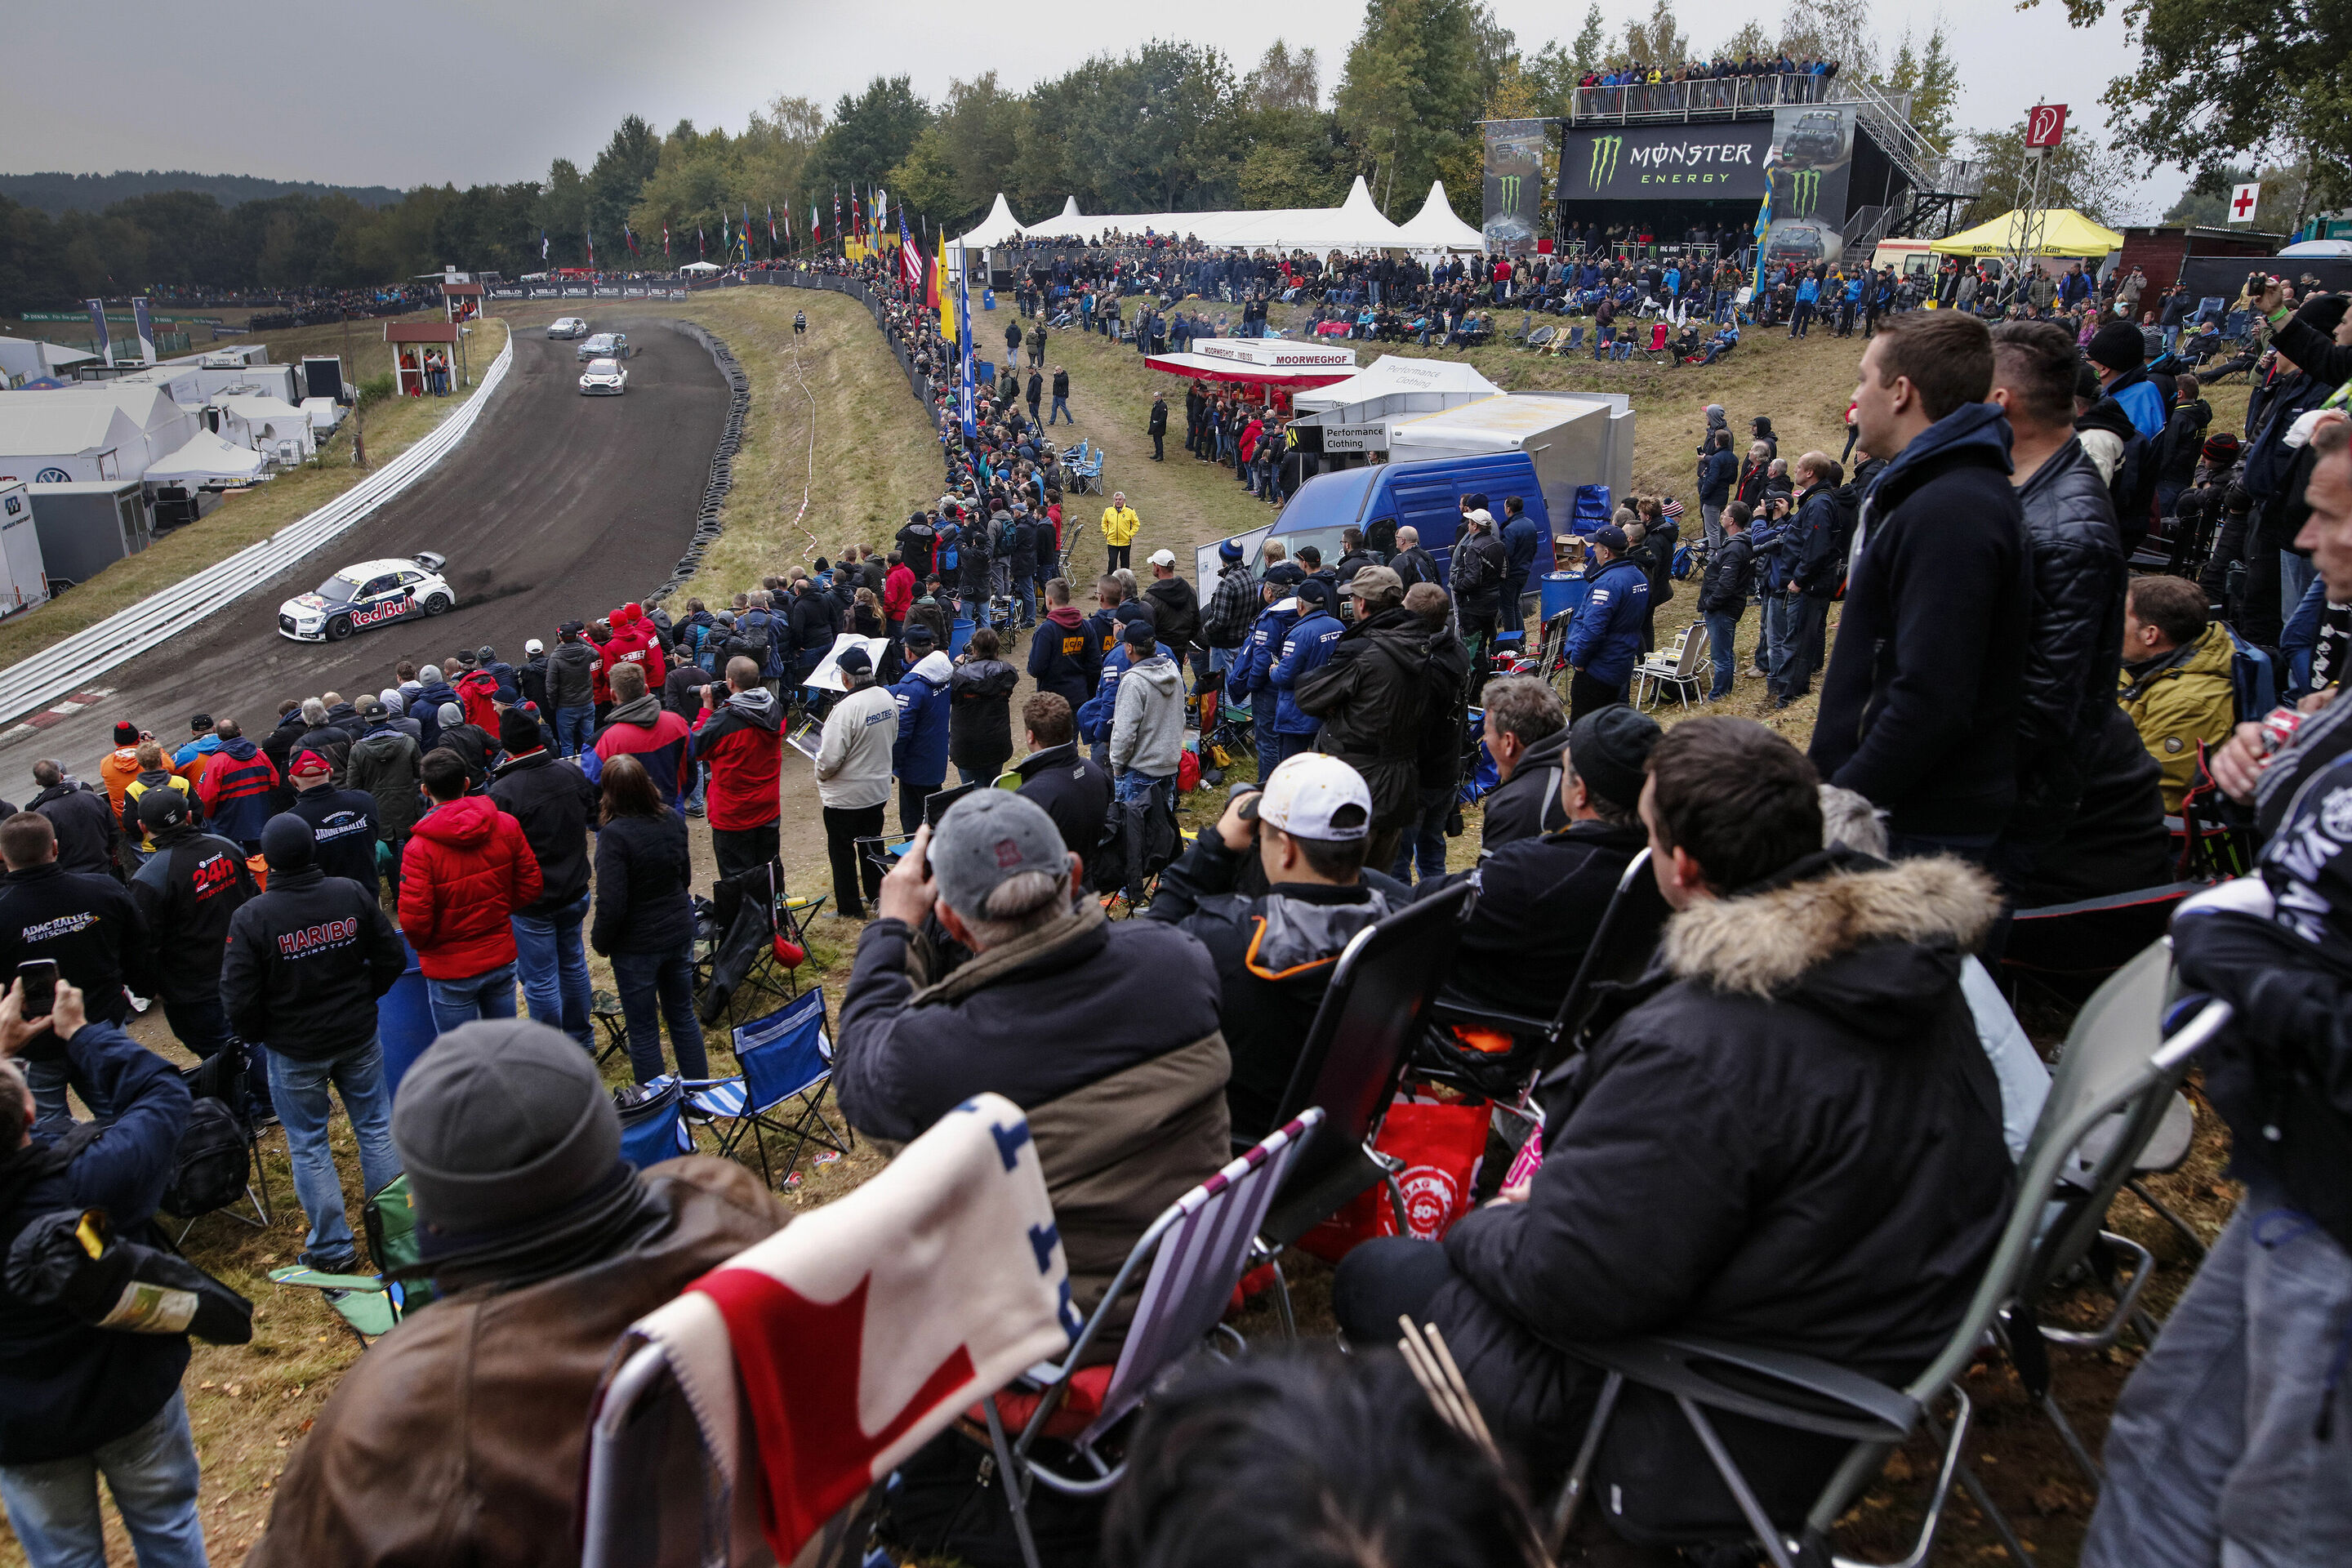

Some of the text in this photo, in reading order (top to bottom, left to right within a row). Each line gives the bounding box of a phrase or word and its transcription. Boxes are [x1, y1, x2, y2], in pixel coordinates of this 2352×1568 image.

[1641, 173, 1730, 184] ENERGY
[1205, 346, 1234, 358] MOORWEGHOF
[1237, 352, 1254, 361] IMBISS
[1276, 355, 1348, 364] MOORWEGHOF
[1387, 364, 1441, 378] Performance
[1396, 376, 1431, 389] Clothing
[1327, 428, 1383, 437] Performance
[1327, 439, 1363, 448] Clothing
[397, 572, 405, 582] 5
[350, 595, 417, 628] Red Bull
[866, 709, 892, 724] PRO TEC
[193, 858, 234, 892] 24h
[22, 911, 91, 937] ADAC RALLYE
[27, 921, 87, 943] DEUTSCHLAND
[278, 916, 357, 954] HARIBO
[283, 937, 357, 960] RACING TEAM
